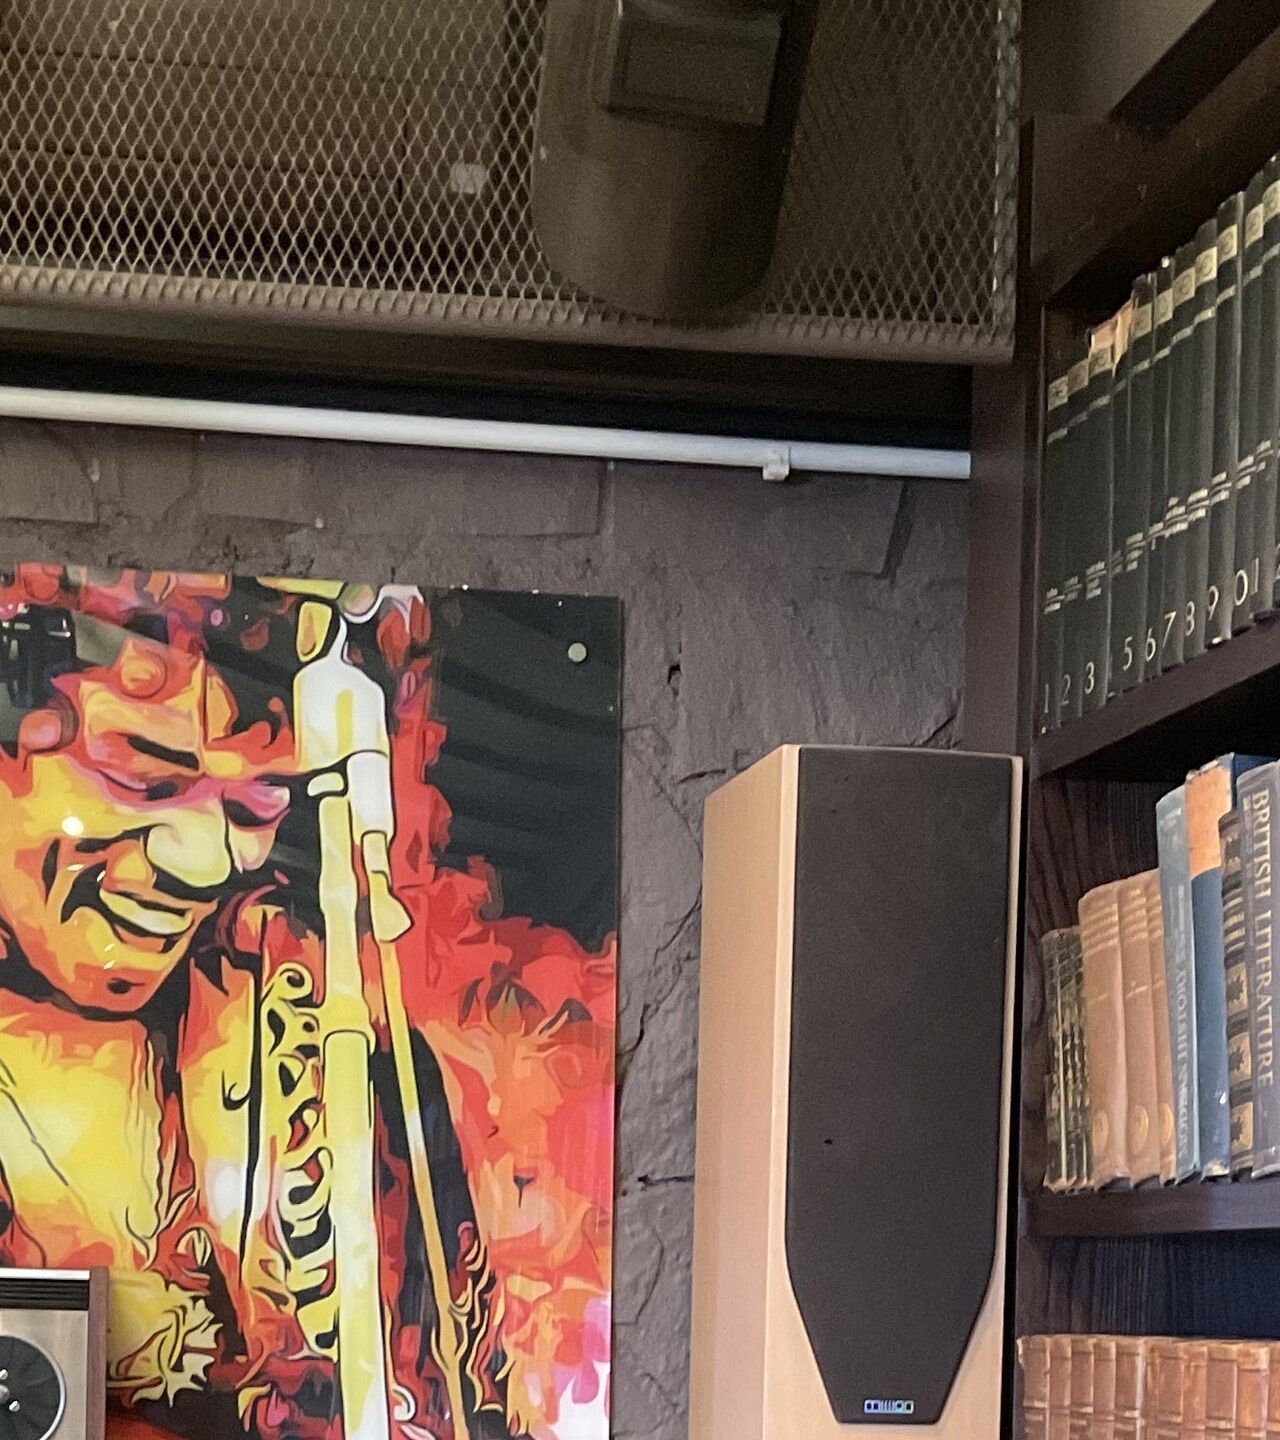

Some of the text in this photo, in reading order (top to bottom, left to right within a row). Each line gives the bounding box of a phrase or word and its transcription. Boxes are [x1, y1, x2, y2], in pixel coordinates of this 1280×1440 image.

[1186, 601, 1196, 636] 8
[1207, 585, 1220, 622] 9
[1144, 628, 1157, 662] 6
[1163, 611, 1177, 648] 7
[1123, 636, 1133, 671] 5
[1060, 674, 1071, 706] 2
[1084, 661, 1096, 695] 3
[1252, 787, 1274, 1088] BRITISH LITERATURE
